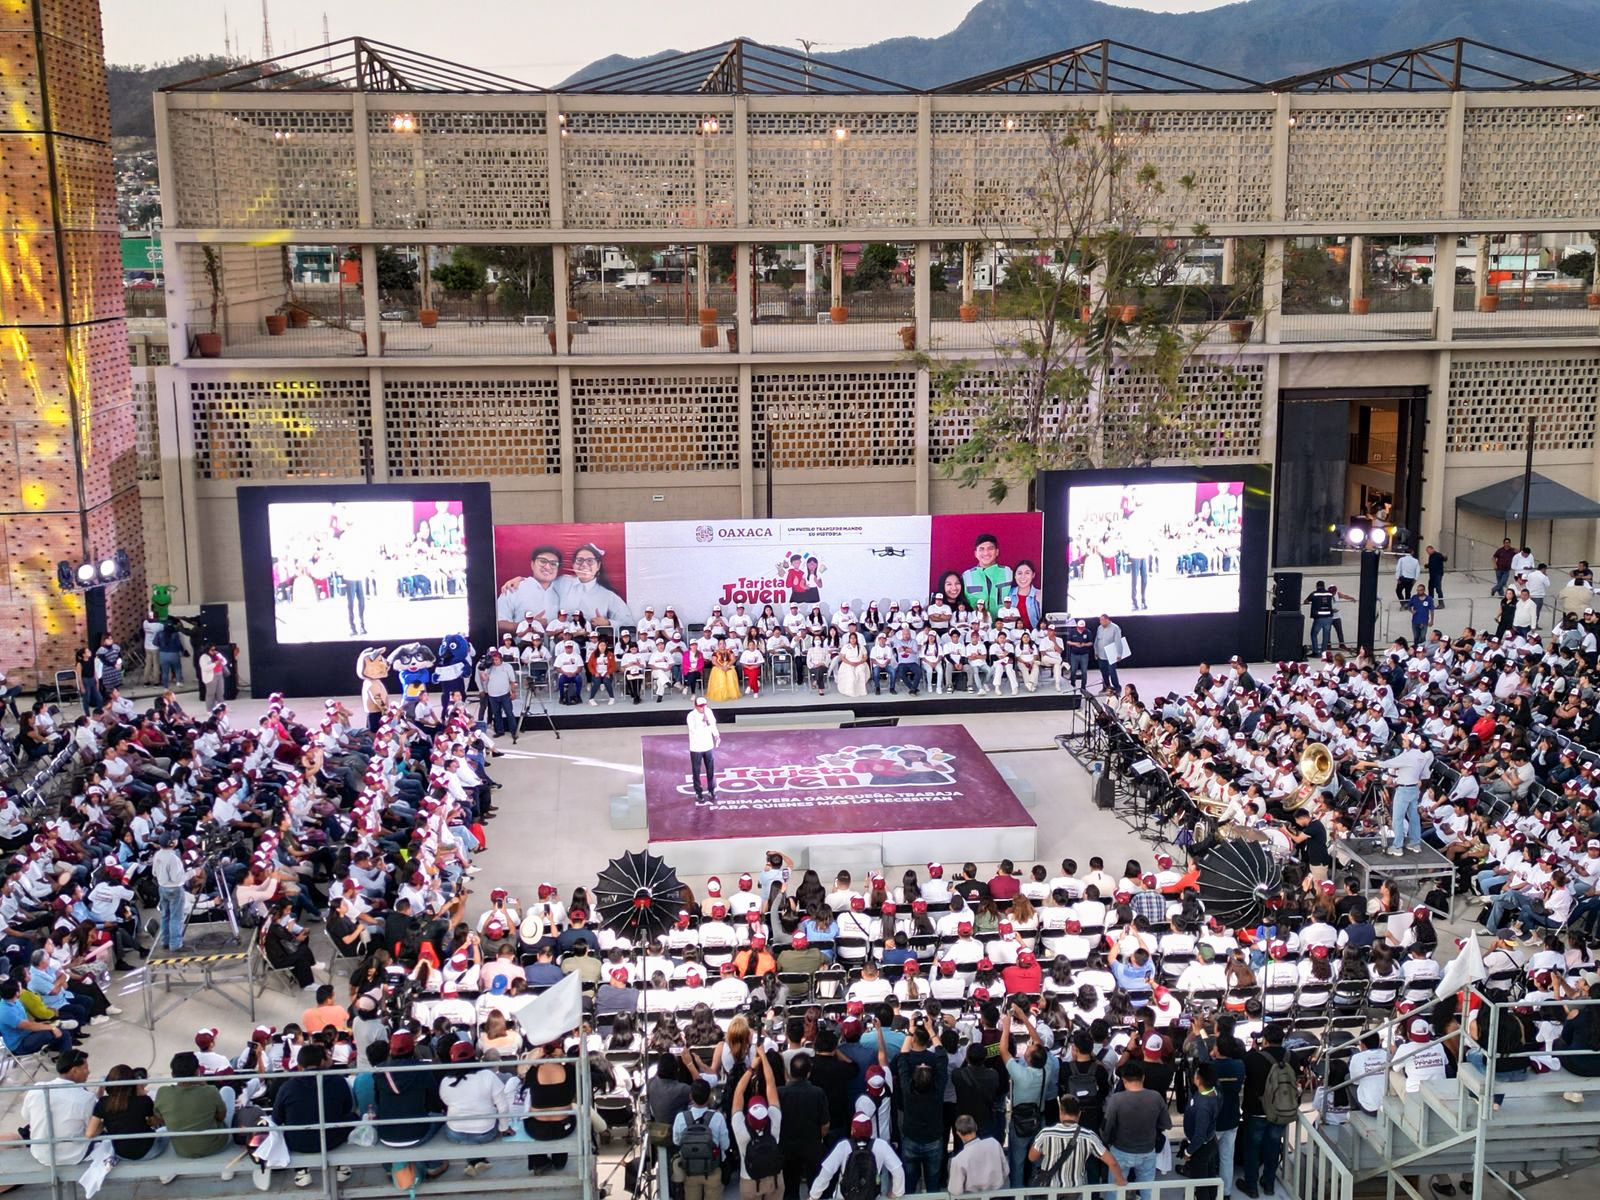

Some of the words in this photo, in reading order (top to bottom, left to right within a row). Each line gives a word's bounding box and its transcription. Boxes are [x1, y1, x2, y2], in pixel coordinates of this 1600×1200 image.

[718, 527, 773, 538] OAXACA
[738, 577, 785, 590] Tarjeta
[718, 583, 787, 606] Joven
[729, 766, 851, 779] Tarjeta
[717, 797, 801, 805] PRIMAVERA
[804, 792, 895, 802] OAXAQUEÑA
[752, 801, 814, 809] QUIENES
